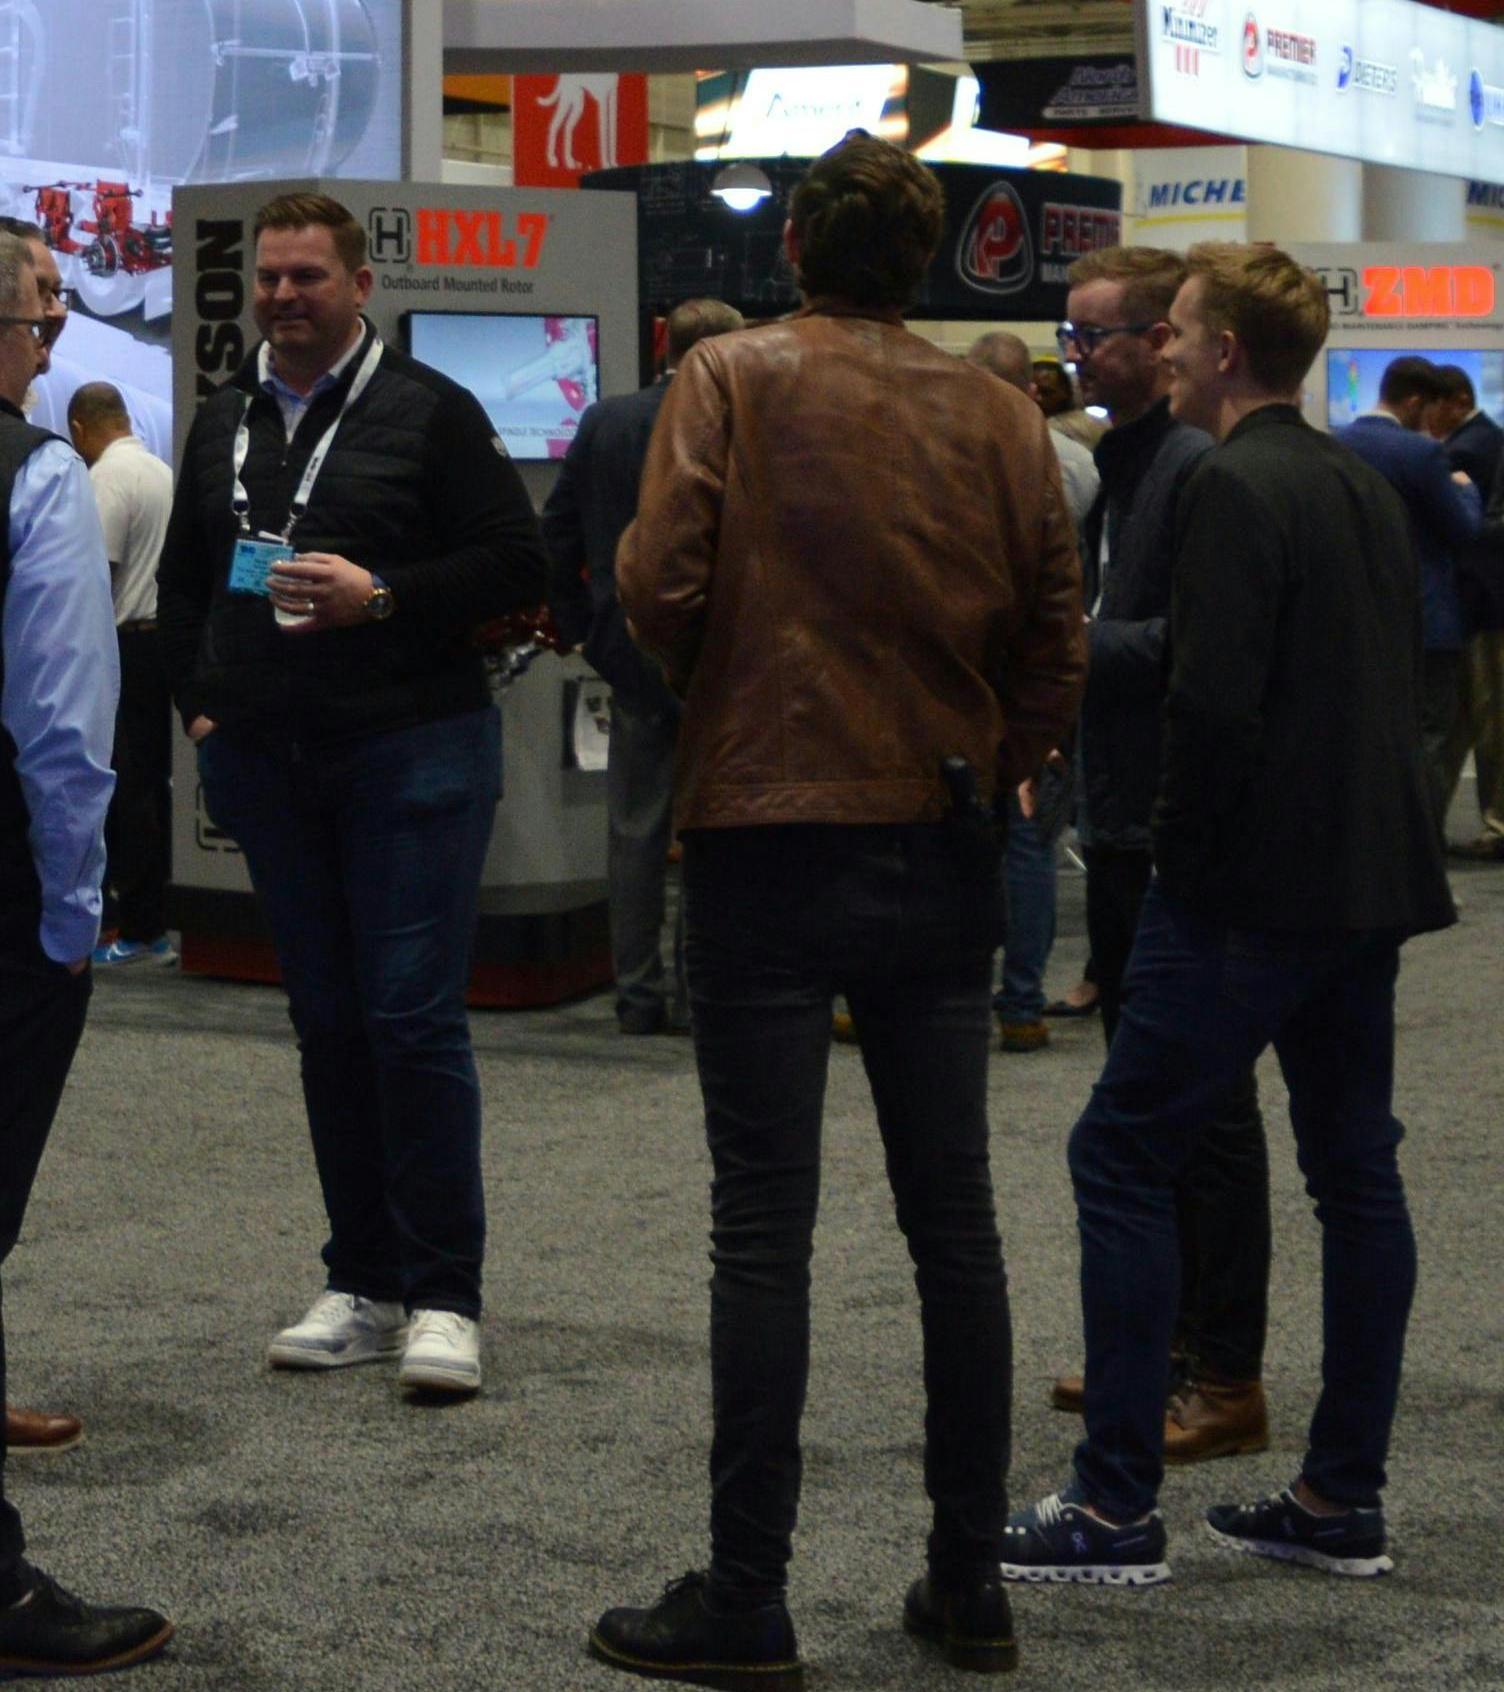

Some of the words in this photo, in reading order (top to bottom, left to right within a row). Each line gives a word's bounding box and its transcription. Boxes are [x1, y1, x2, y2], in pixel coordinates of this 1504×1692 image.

[416, 208, 549, 269] HXL7
[382, 274, 440, 291] Outboard
[443, 276, 497, 293] Mounted
[500, 278, 534, 294] Rotor
[1363, 265, 1495, 317] ZMD
